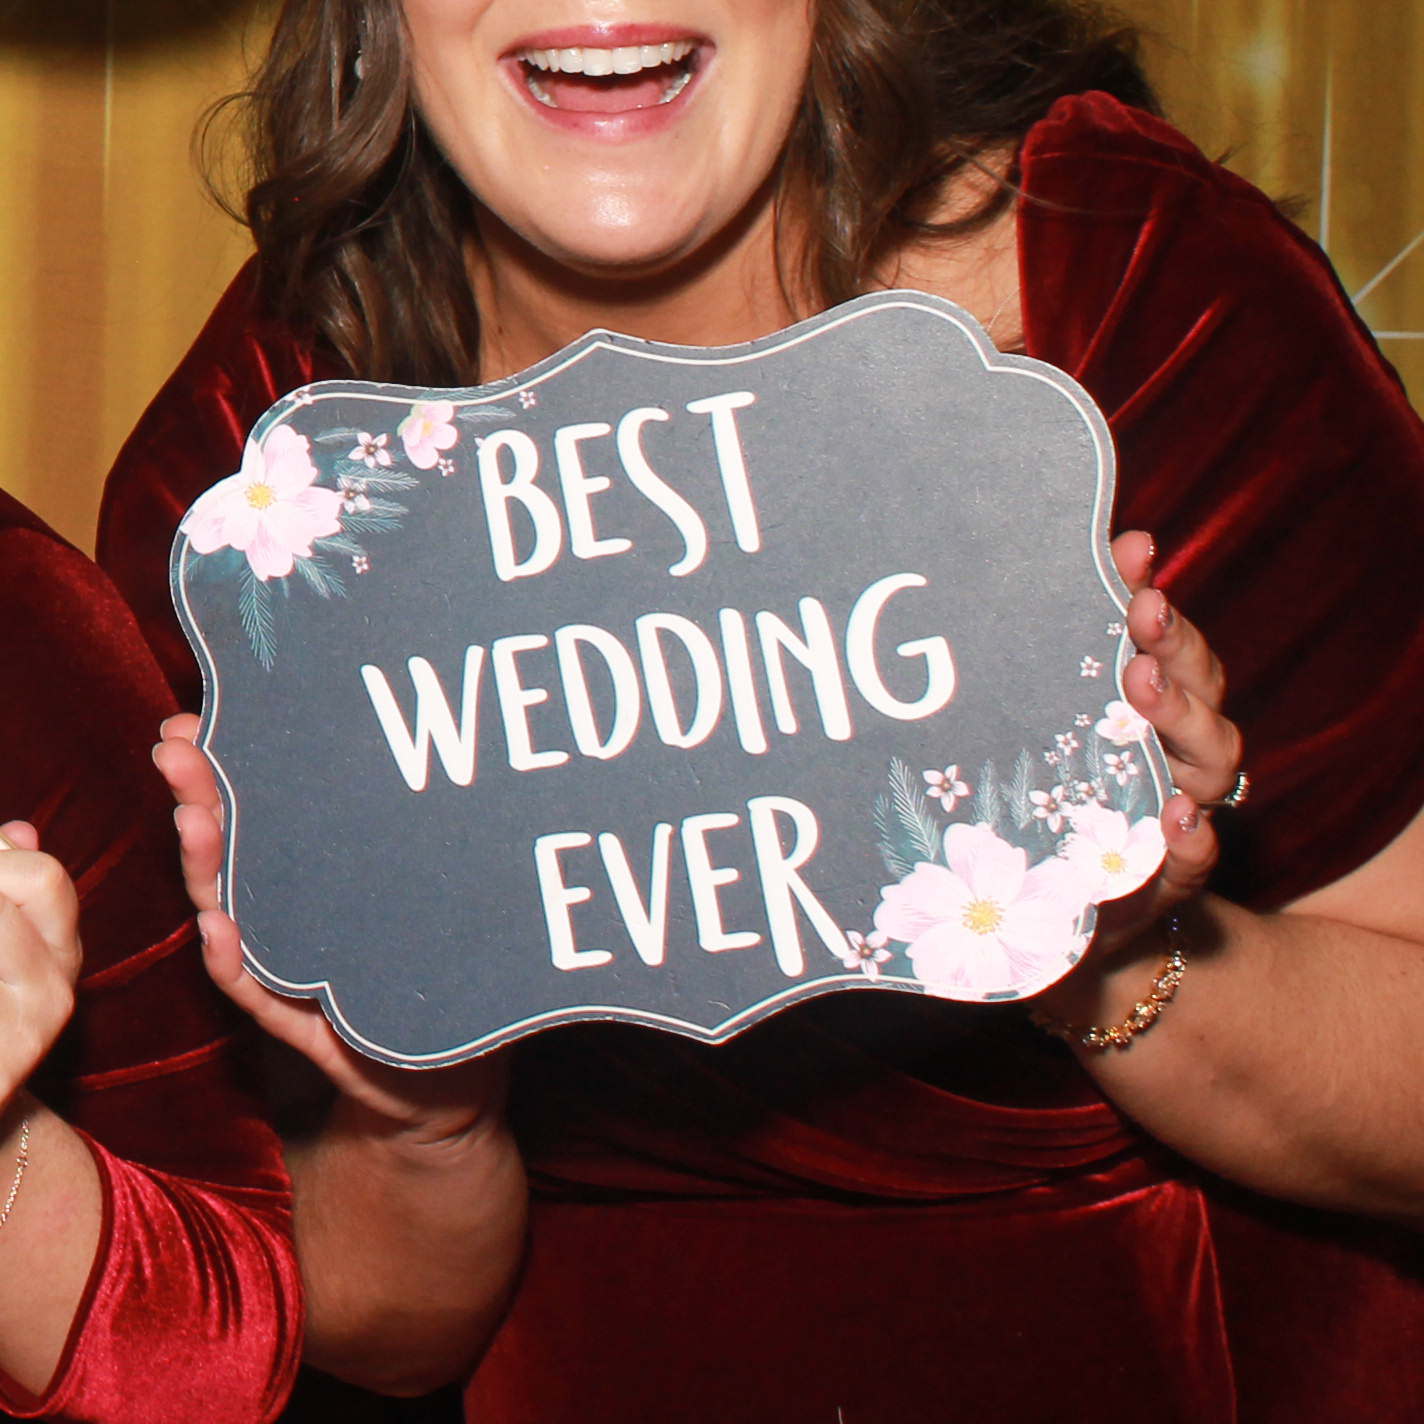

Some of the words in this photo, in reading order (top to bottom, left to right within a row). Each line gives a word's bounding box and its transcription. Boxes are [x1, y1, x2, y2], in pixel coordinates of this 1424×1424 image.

[477, 391, 761, 580] BEST
[361, 572, 955, 792] WEDDING
[534, 795, 850, 977] EVER
